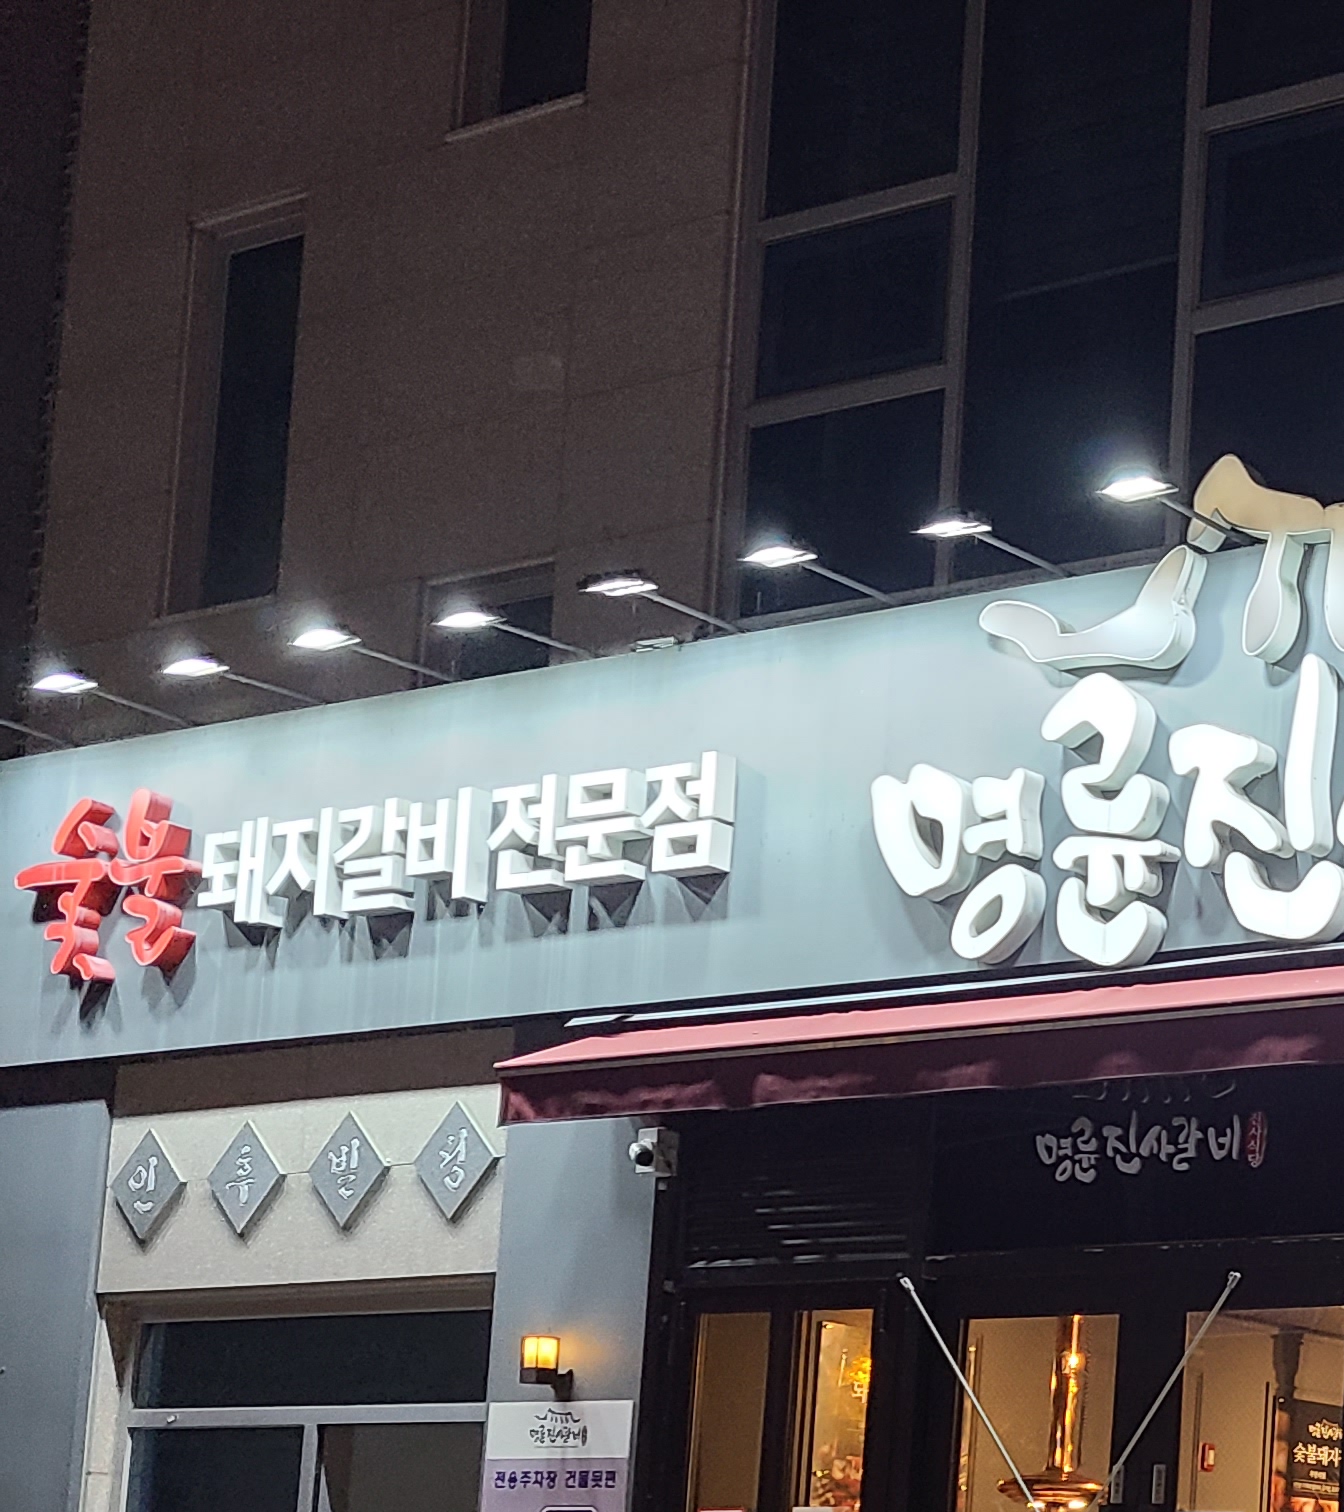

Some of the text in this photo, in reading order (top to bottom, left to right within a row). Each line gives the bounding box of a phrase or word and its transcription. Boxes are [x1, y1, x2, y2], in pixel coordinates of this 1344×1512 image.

[487, 750, 738, 896] 전문점
[1035, 1109, 1241, 1184] 명륜진사갈비
[1292, 1441, 1342, 1468] 숯불돼지
